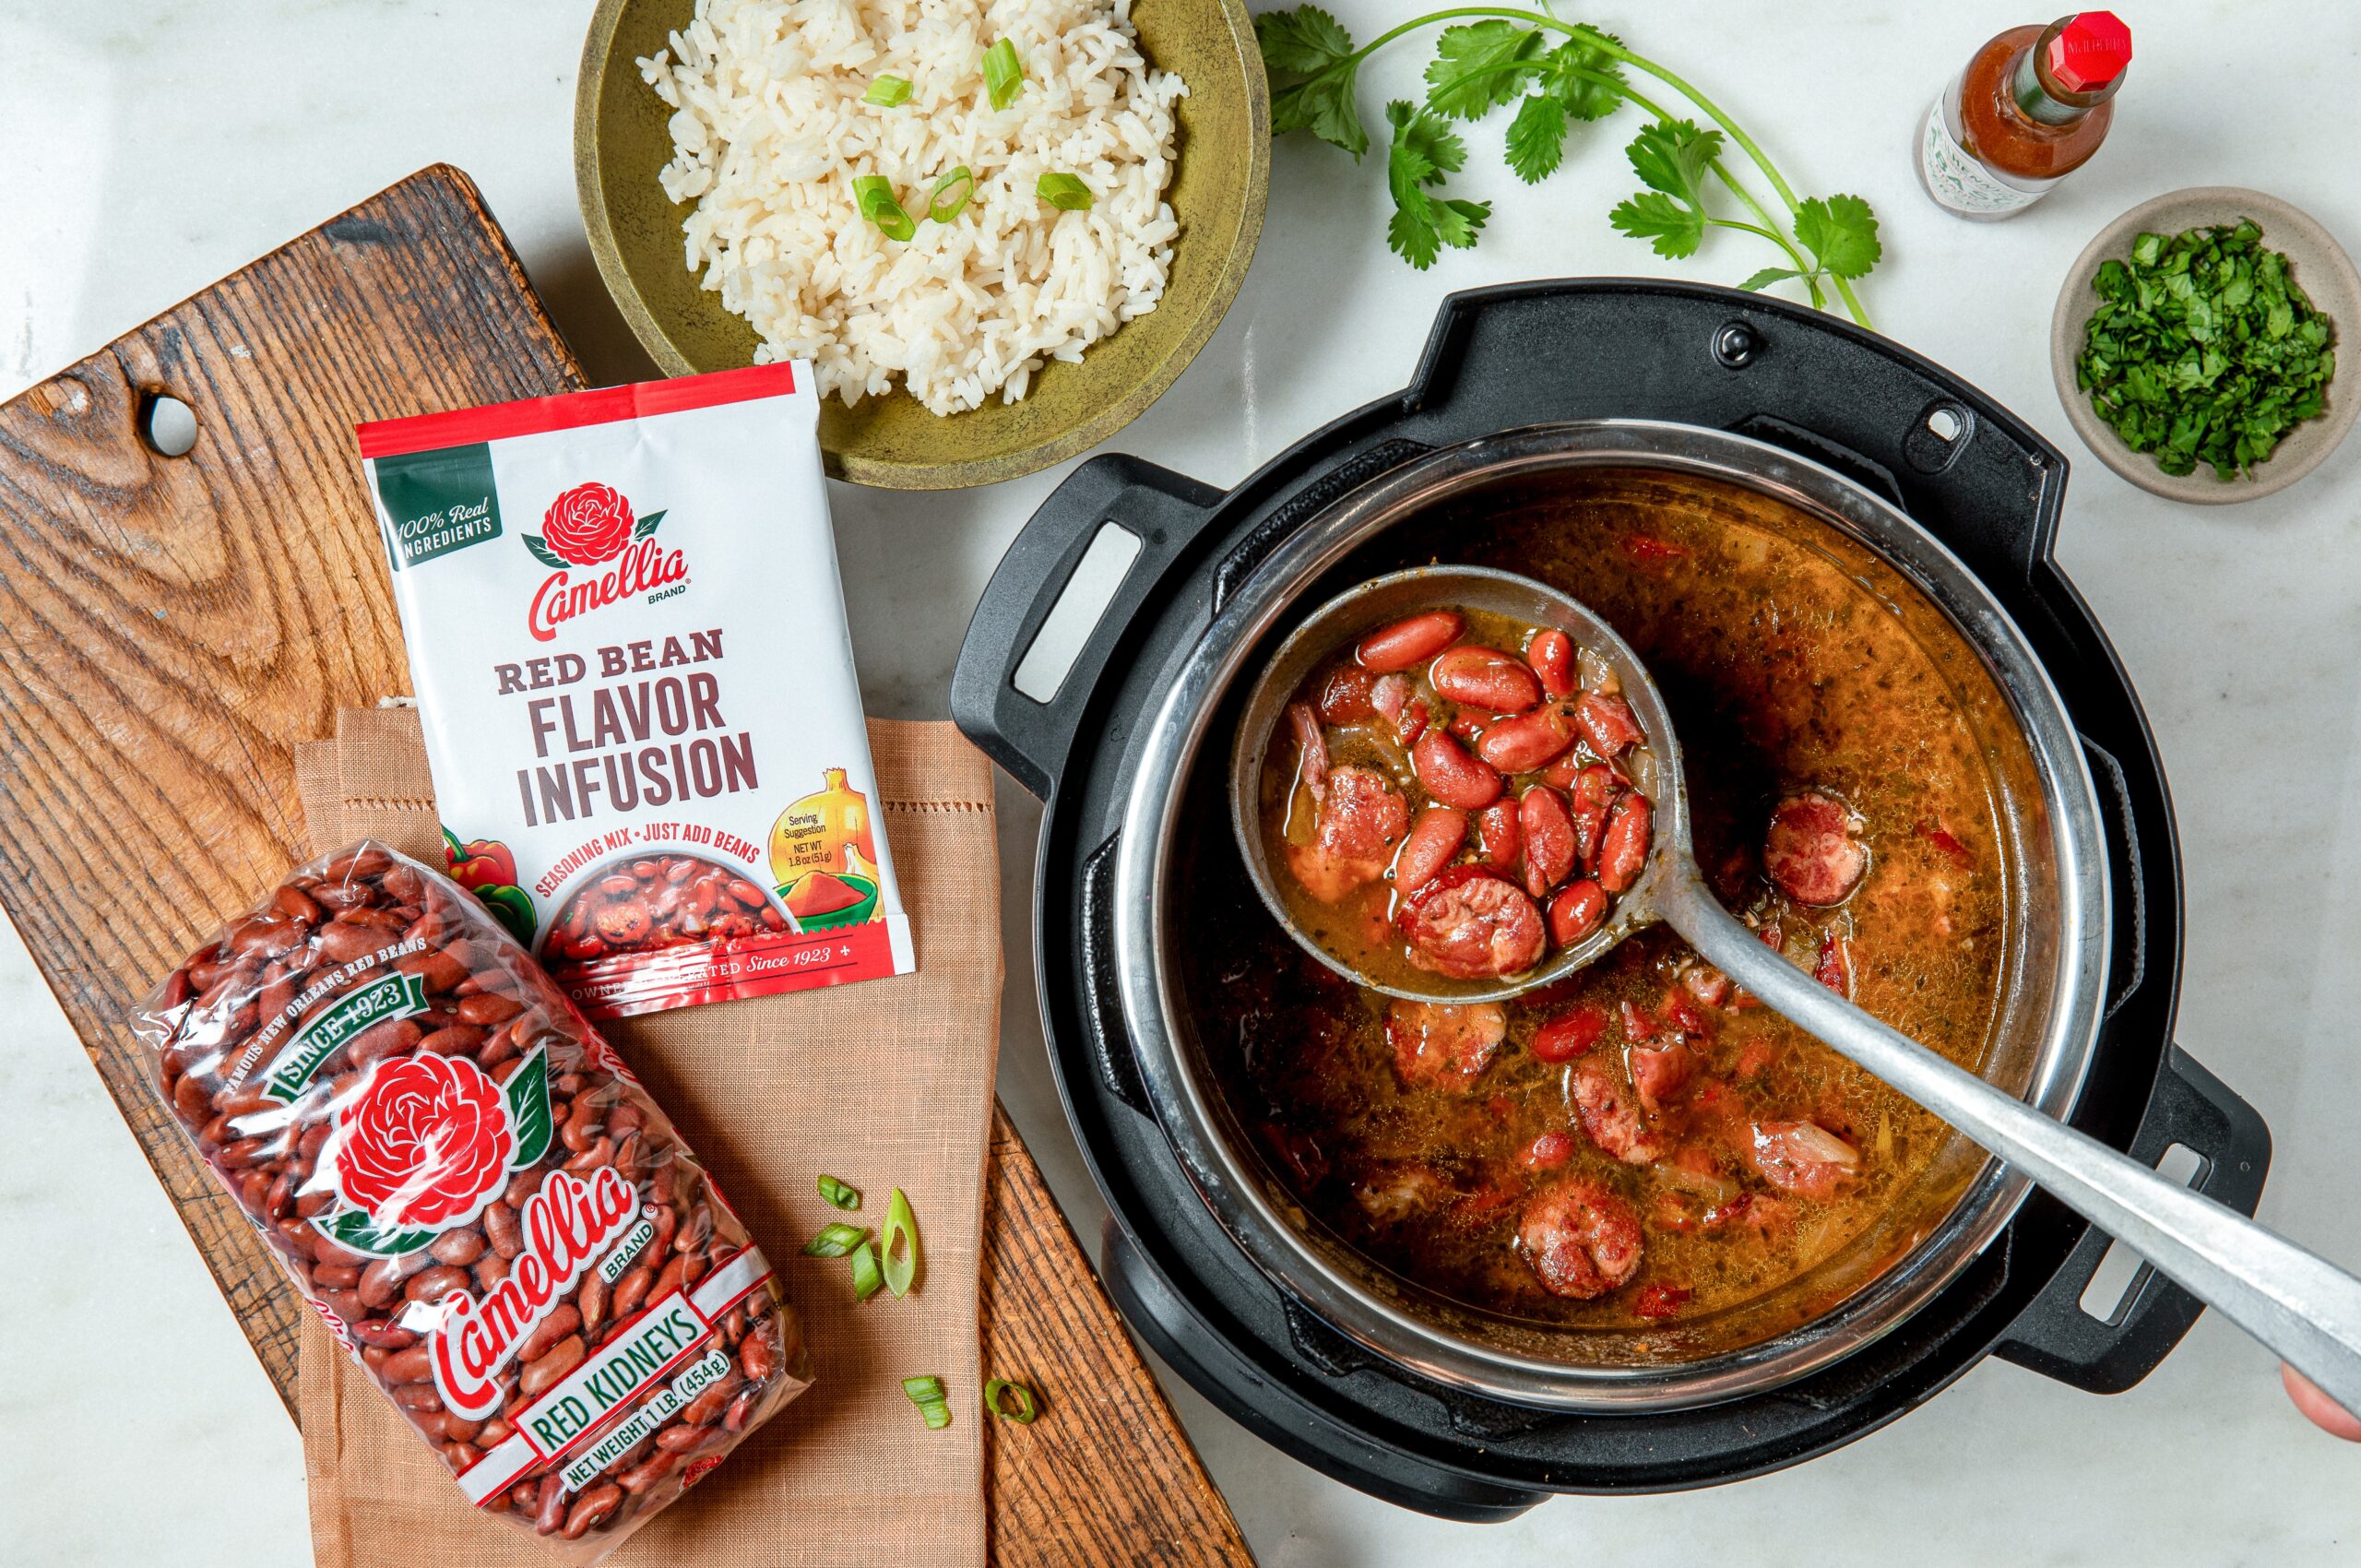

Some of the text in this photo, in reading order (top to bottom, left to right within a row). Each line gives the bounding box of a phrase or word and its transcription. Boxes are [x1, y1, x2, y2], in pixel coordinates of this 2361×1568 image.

[397, 496, 489, 541] 100% Real
[401, 517, 492, 559] NGREDIENTS
[528, 537, 689, 642] Camellia
[648, 585, 686, 604] BRAND
[494, 628, 724, 695] RED BEAN
[528, 672, 727, 757] FLAVOR
[516, 732, 759, 827] INFUSION
[784, 825, 826, 838] Suggestion
[789, 814, 818, 826] Serving
[794, 840, 822, 854] NET WT
[535, 823, 761, 898] SEASONING MIX JUST ADD BEANS
[789, 850, 832, 867] 1.8 oz (51g)
[572, 981, 628, 1000] OWNE
[746, 955, 789, 972] Since
[793, 947, 832, 965] 1923
[224, 937, 428, 1096] FAMOUS NEW ORLEANS RED BEANS
[280, 982, 401, 1083] SINCE 1923
[605, 1223, 653, 1280] BRAND
[433, 1166, 634, 1410] Camellia
[531, 1309, 699, 1452] RED KIDNEYS
[567, 1352, 730, 1486] NET WEIGHT 1 LB. (454g)
